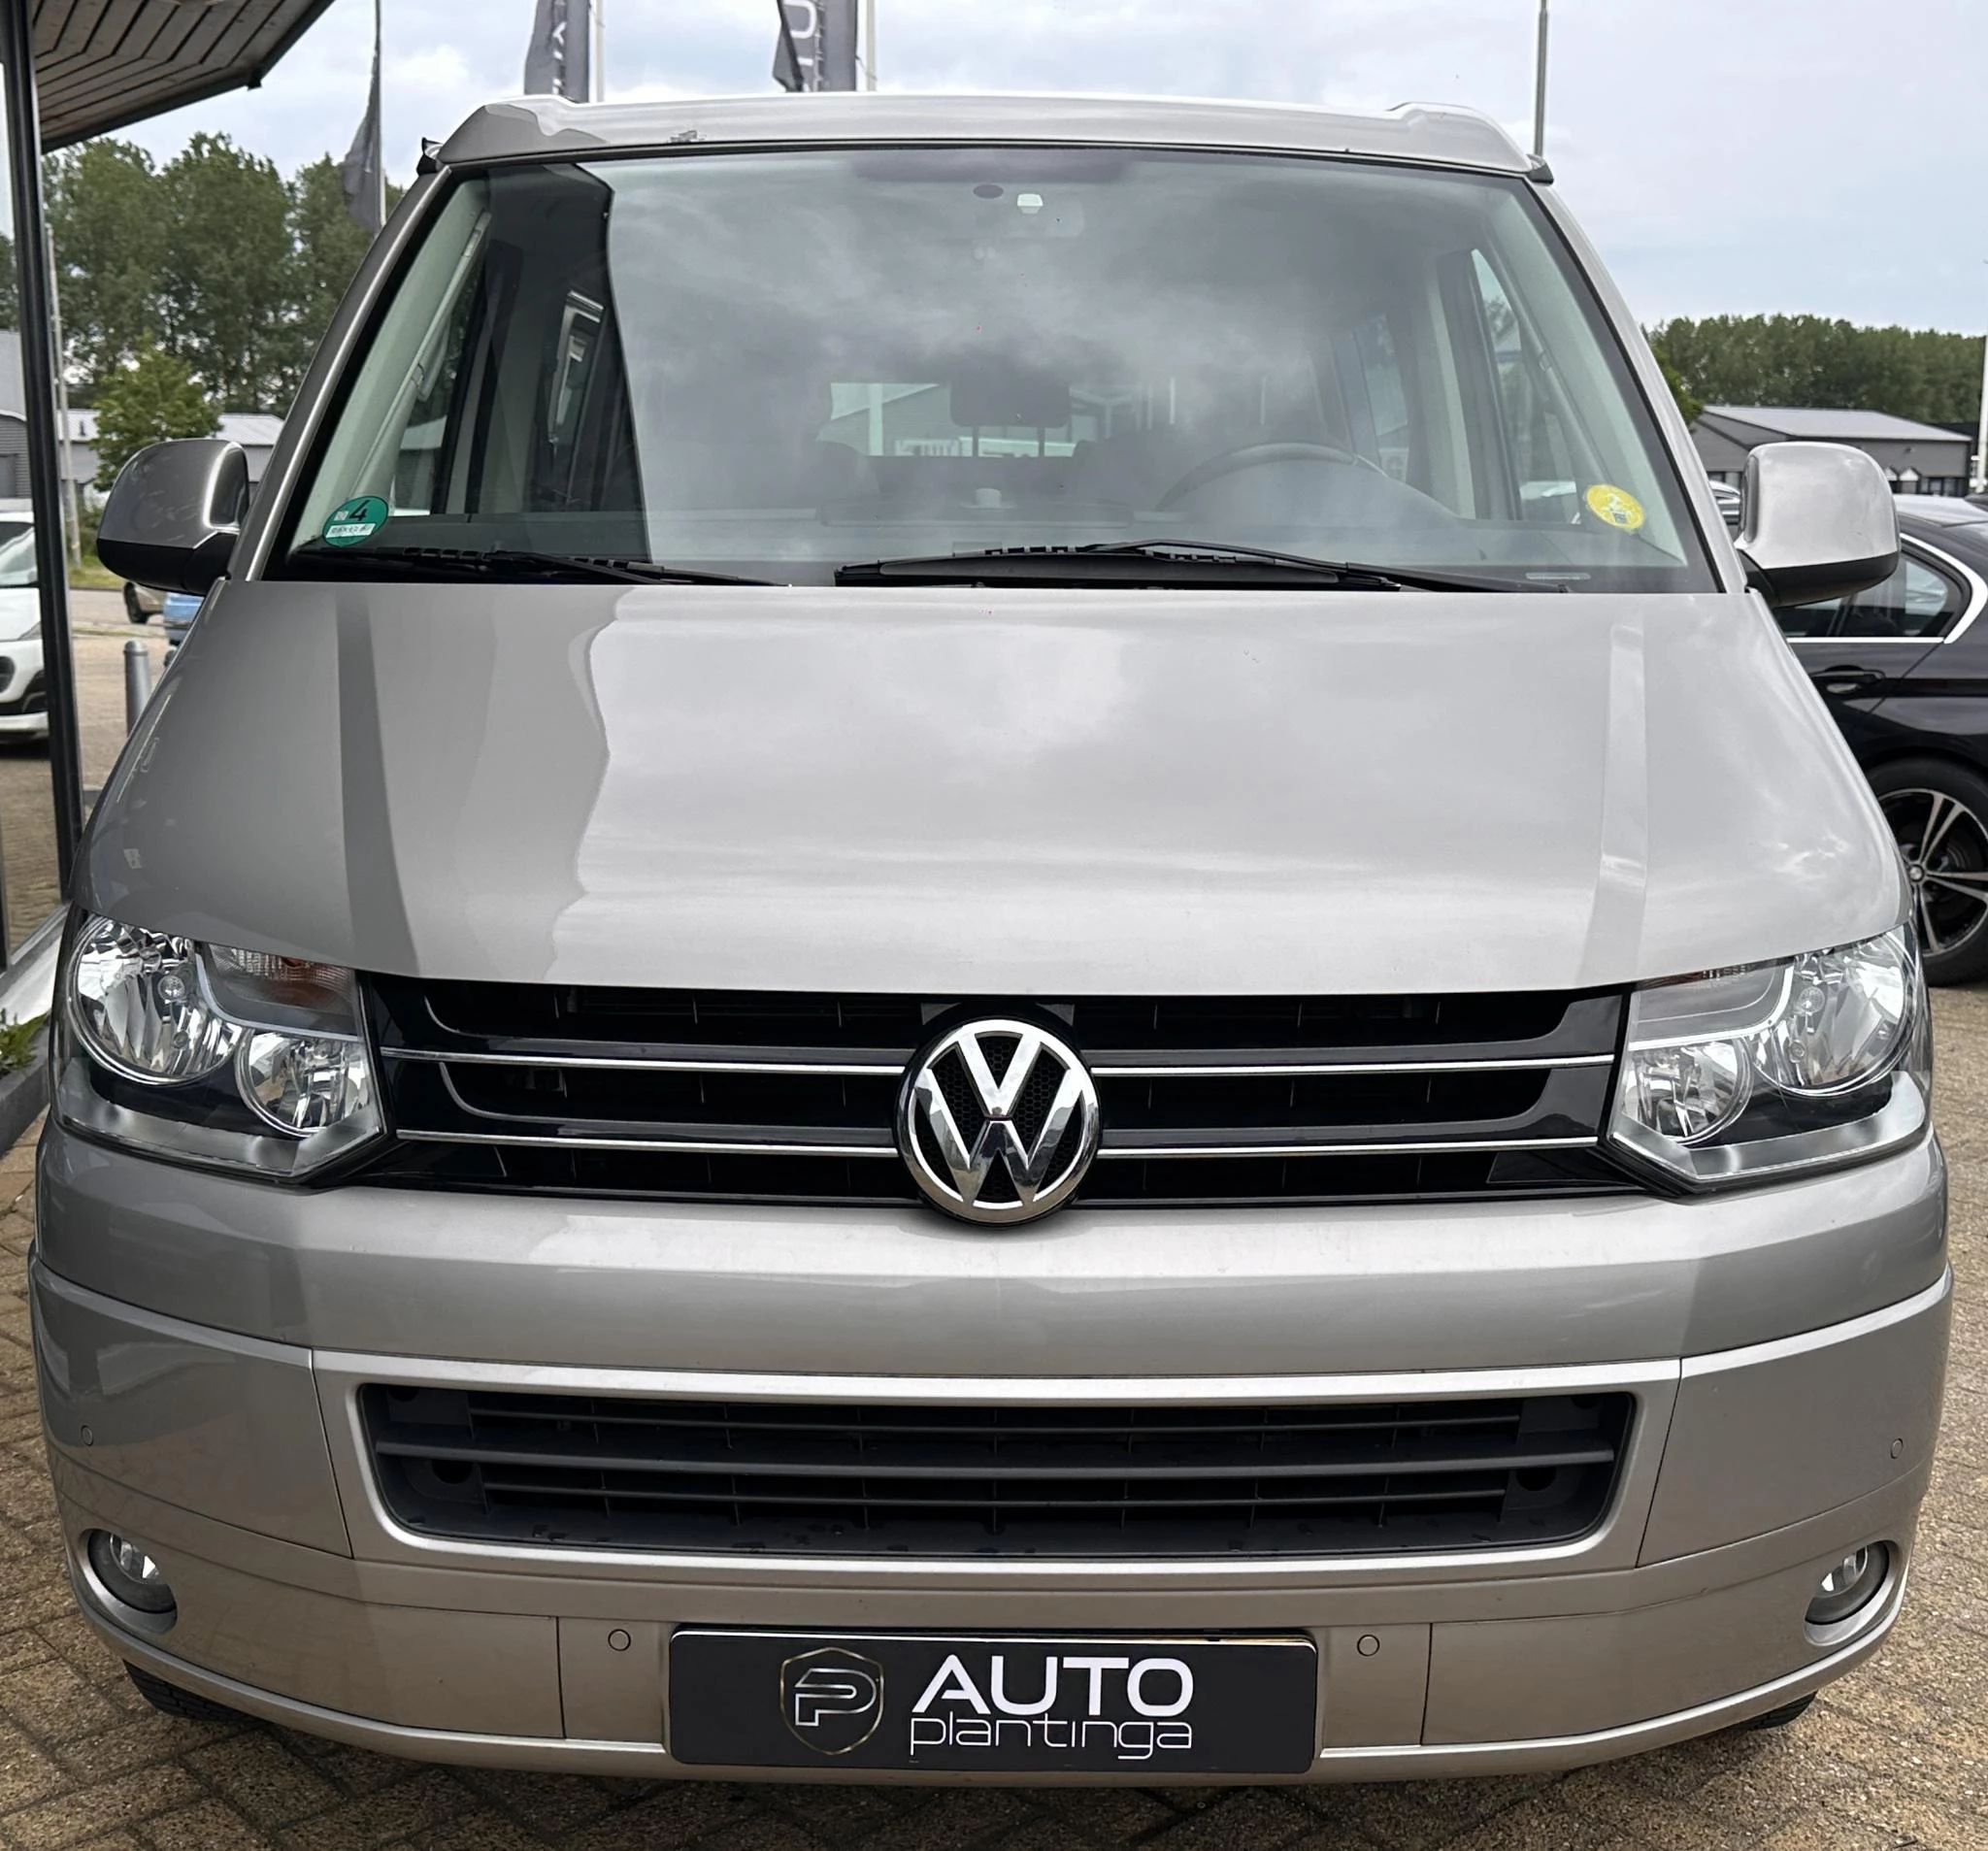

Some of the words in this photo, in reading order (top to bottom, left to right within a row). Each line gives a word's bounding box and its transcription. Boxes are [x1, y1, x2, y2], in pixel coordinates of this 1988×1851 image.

[349, 499, 370, 521] 4
[906, 1020, 1096, 1220] VW
[911, 1654, 1193, 1717] AUTO
[910, 1711, 1193, 1760] plantinga
